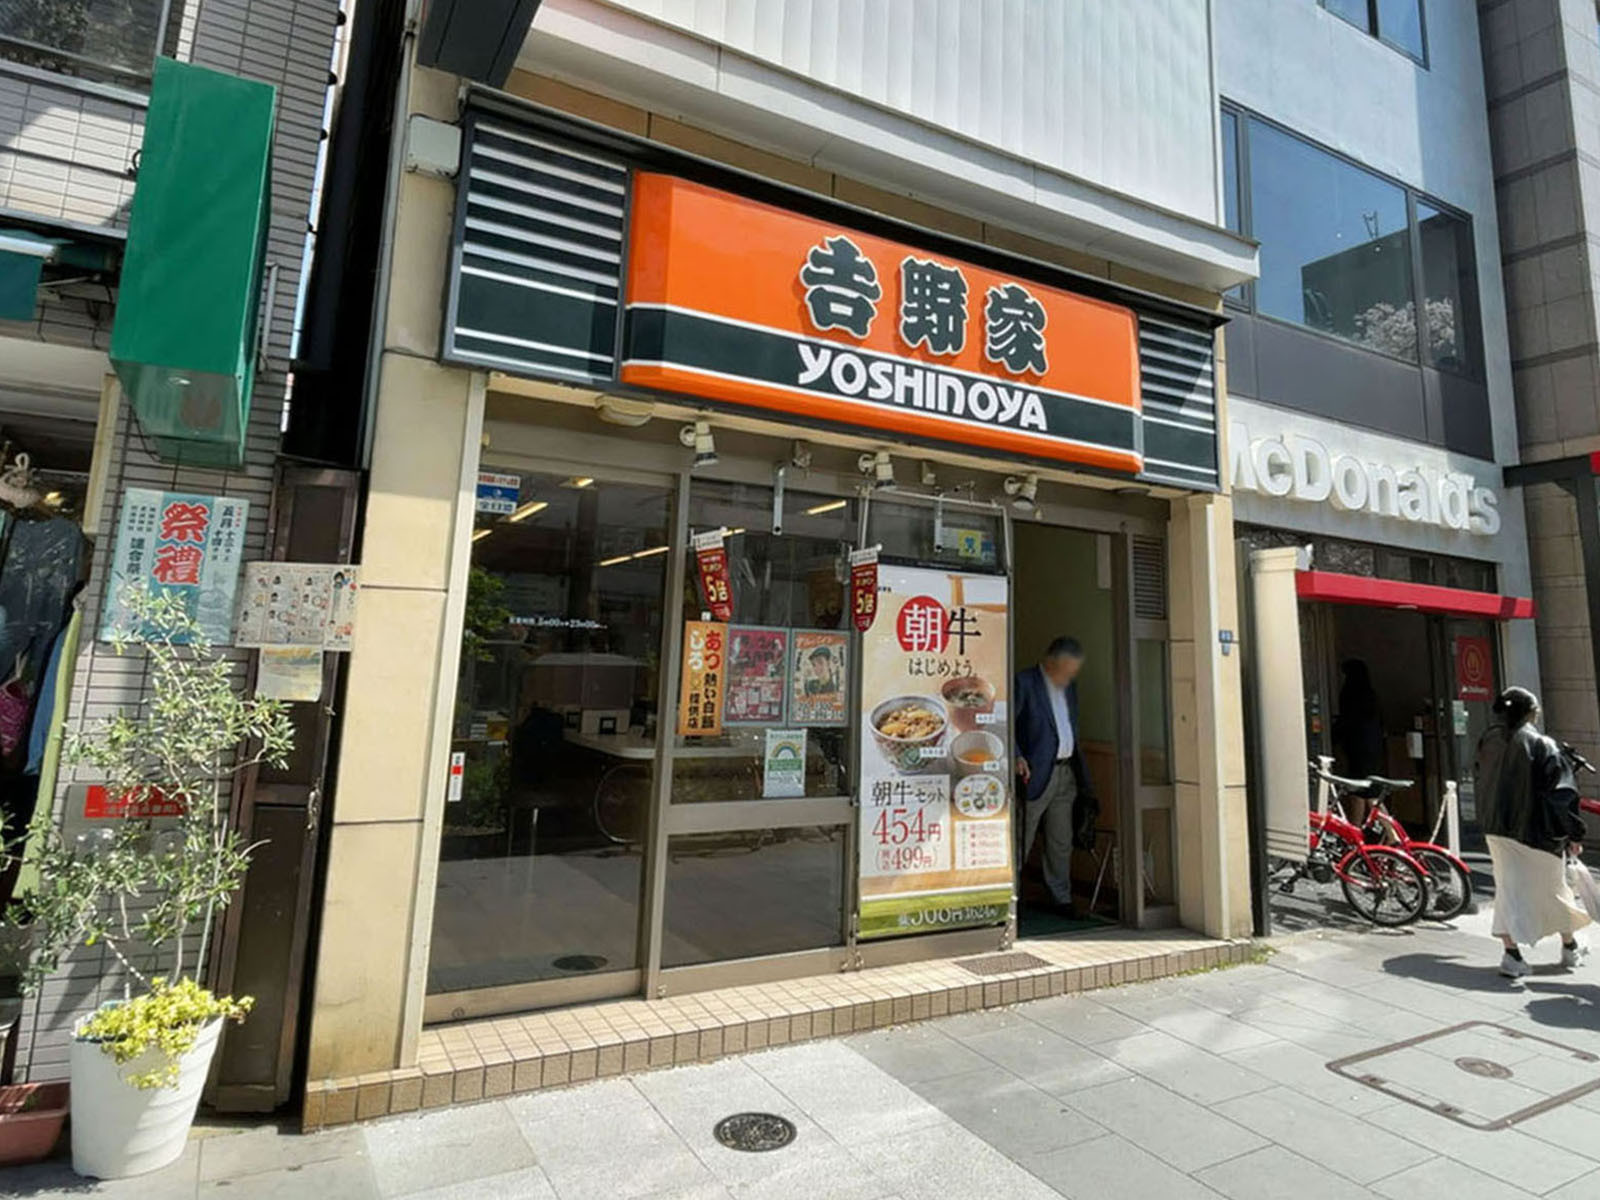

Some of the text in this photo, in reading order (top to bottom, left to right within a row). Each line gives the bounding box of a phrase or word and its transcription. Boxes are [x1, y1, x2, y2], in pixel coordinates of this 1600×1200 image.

[902, 604, 982, 656] 朝牛
[871, 780, 946, 807] 朝牛セット
[872, 808, 941, 845] 454円
